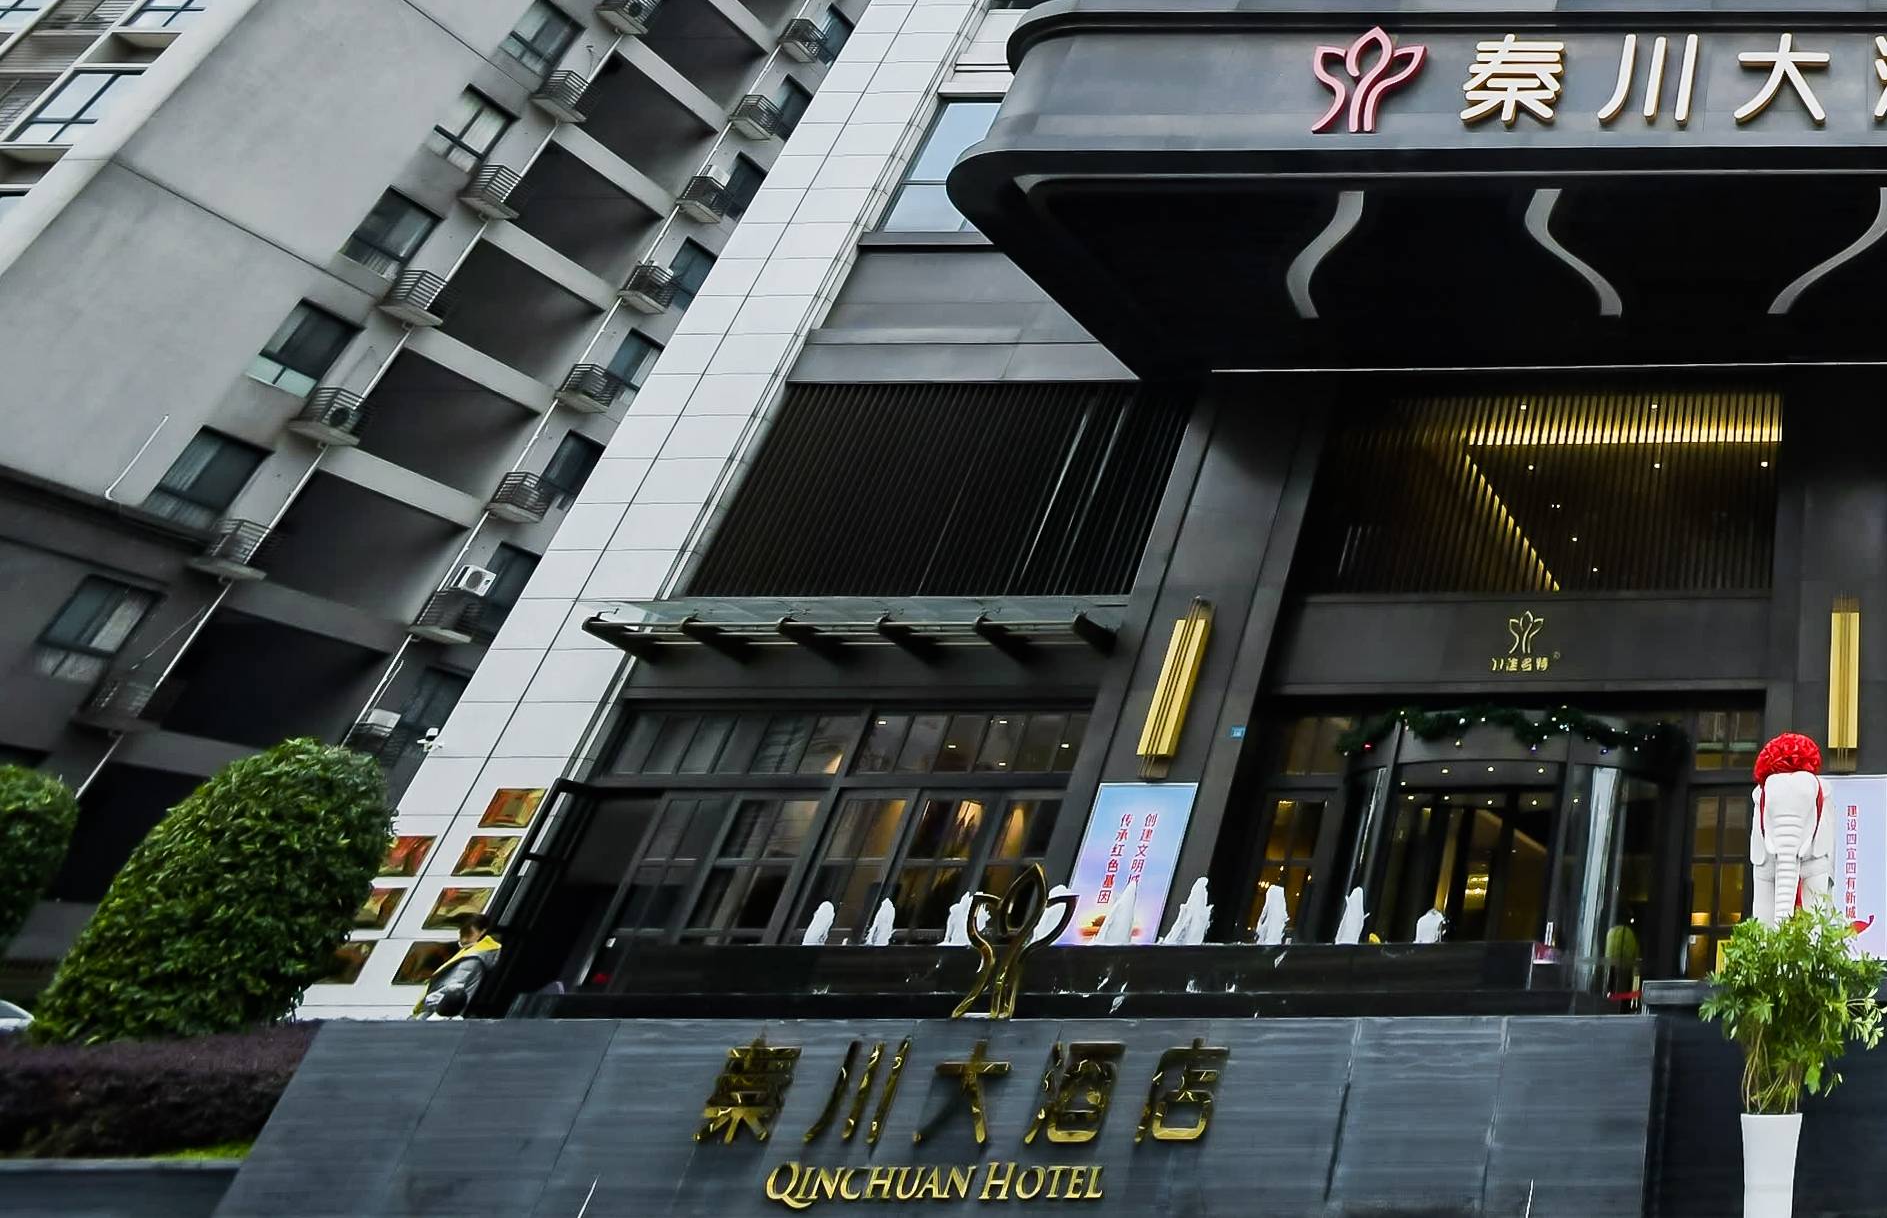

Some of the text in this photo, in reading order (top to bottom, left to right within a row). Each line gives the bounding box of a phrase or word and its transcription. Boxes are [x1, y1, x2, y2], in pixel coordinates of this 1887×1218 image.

[1097, 813, 1133, 903] 传承红色基因
[693, 1028, 1230, 1143] 秦川大酒店
[765, 1161, 1103, 1208] QINCHUAN HOTEL
